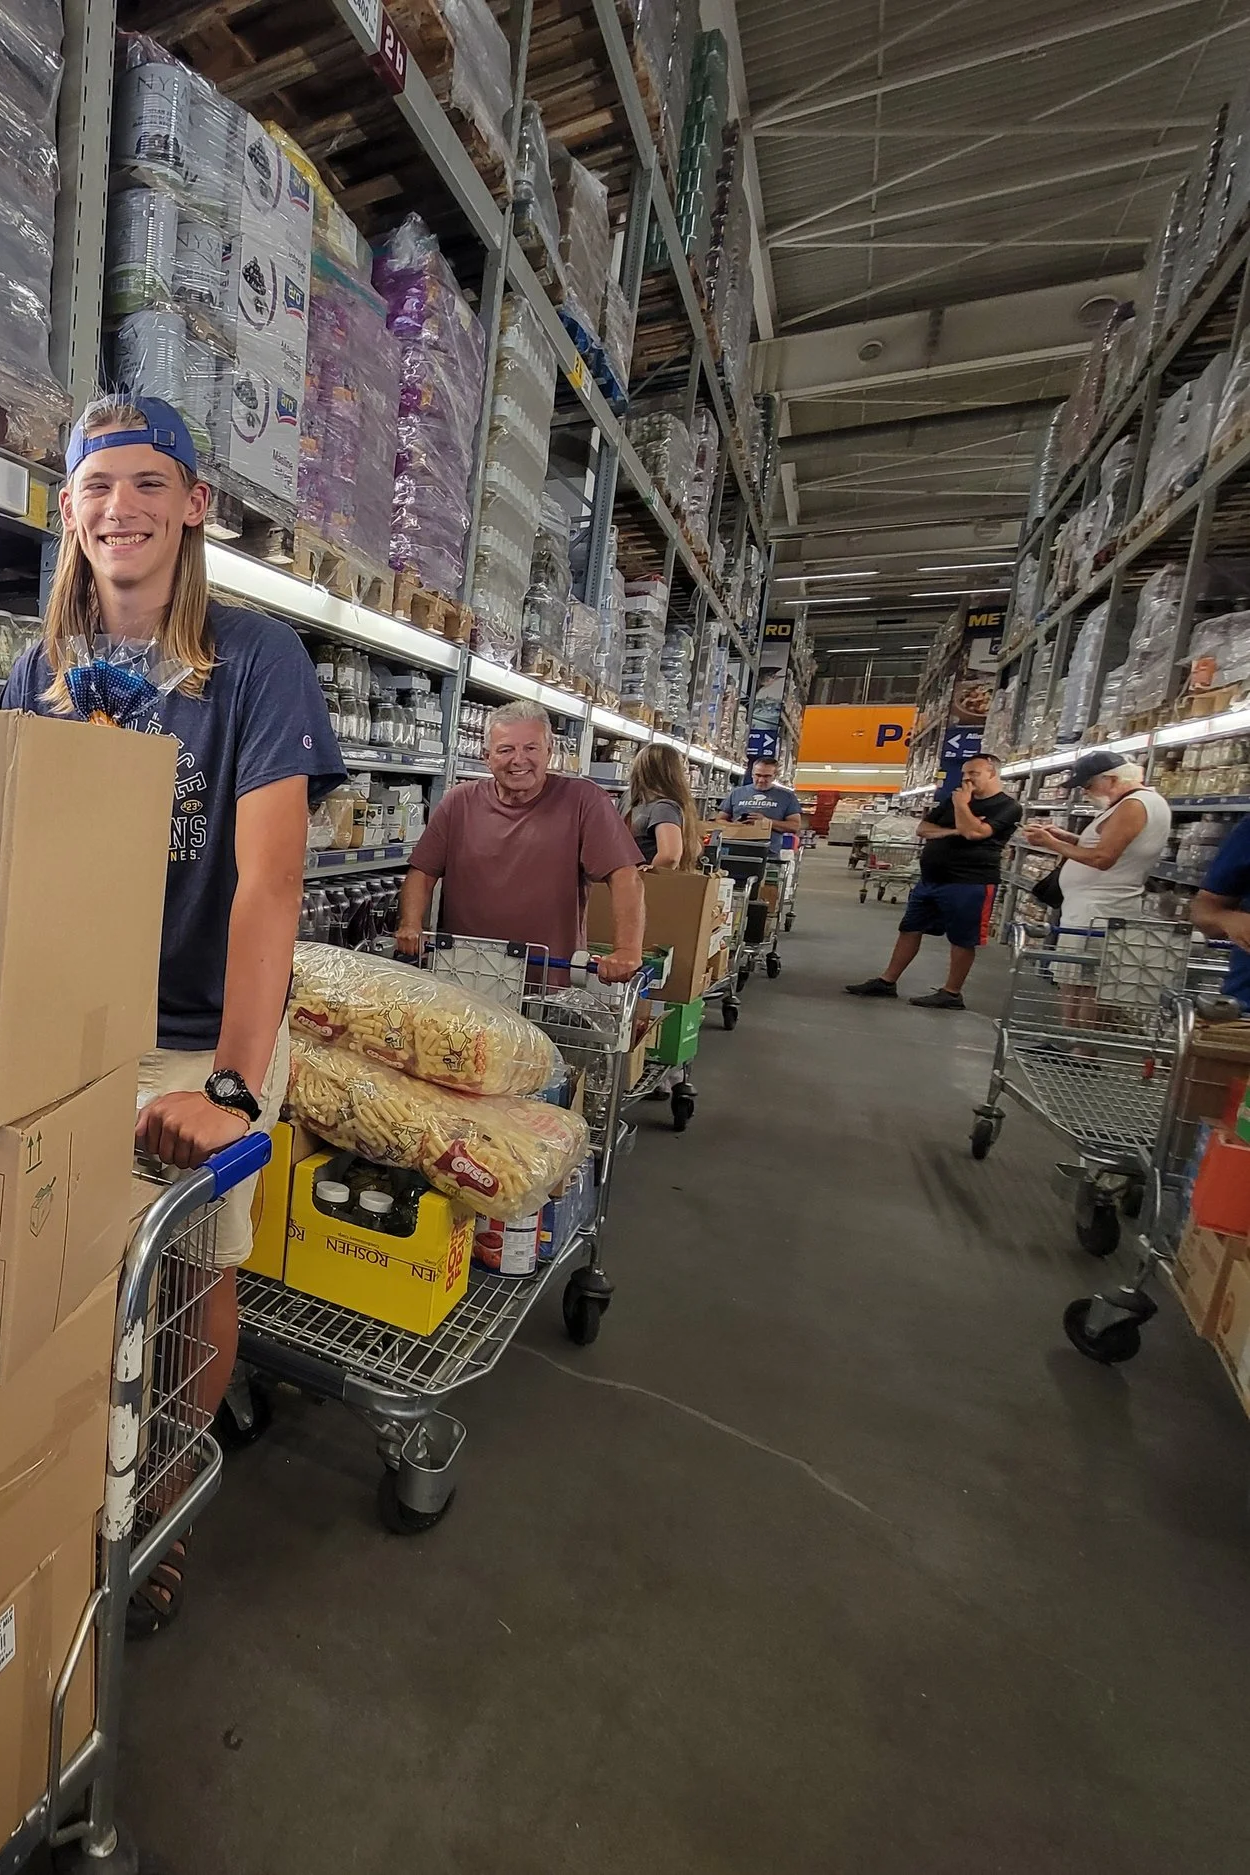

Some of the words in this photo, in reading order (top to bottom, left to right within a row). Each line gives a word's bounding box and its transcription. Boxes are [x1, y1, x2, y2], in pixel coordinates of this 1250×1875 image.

[765, 624, 791, 636] RO
[186, 802, 198, 811] 23
[738, 799, 778, 808] MICHIGAN
[169, 815, 207, 850] NS
[326, 1236, 389, 1268] ROSHEN
